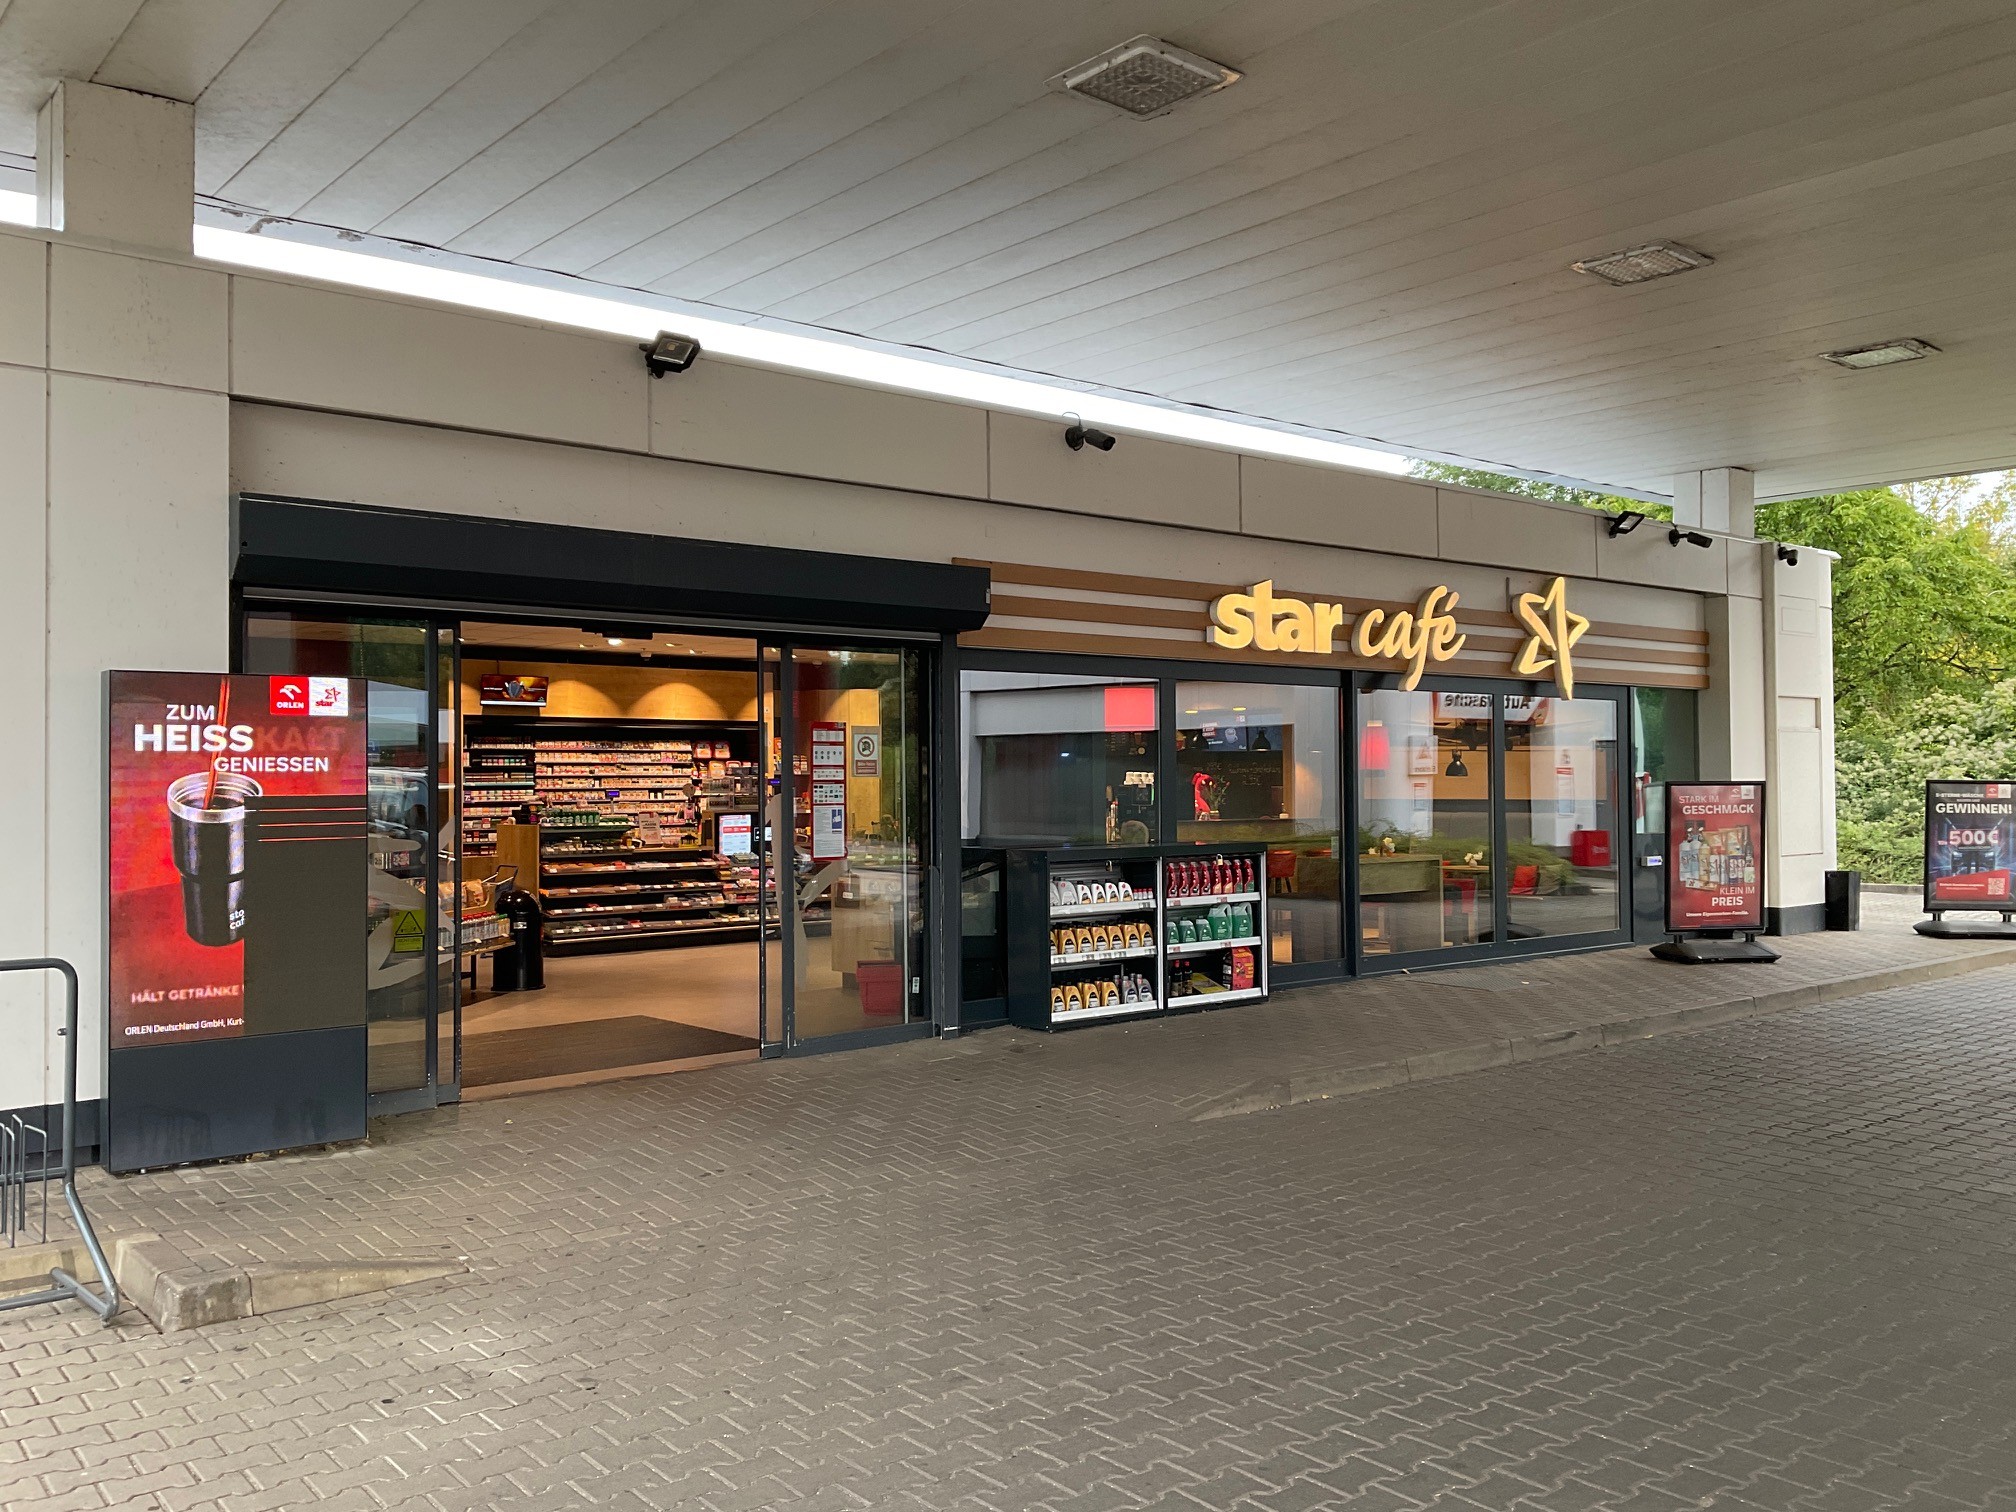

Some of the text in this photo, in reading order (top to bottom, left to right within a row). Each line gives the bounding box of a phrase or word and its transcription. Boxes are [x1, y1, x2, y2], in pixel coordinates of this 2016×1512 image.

[1207, 579, 1466, 691] star café
[276, 701, 305, 709] ORLEN
[166, 704, 216, 721] ZUM
[134, 723, 254, 752] HEISS
[214, 756, 329, 773] GENIESSEN
[1678, 794, 1720, 804] STARK IM
[1682, 803, 1755, 815] GESCHMACK
[1935, 802, 2013, 814] GEWINNEN!
[1719, 886, 1755, 895] KLEIN IM
[1711, 896, 1744, 907] PREIS
[131, 989, 166, 1003] HÄLT
[168, 984, 239, 1001] GETRÄNKE
[124, 1025, 153, 1036] ORLEN
[153, 1020, 199, 1034] Deutschland
[200, 1018, 226, 1029] GmbH,
